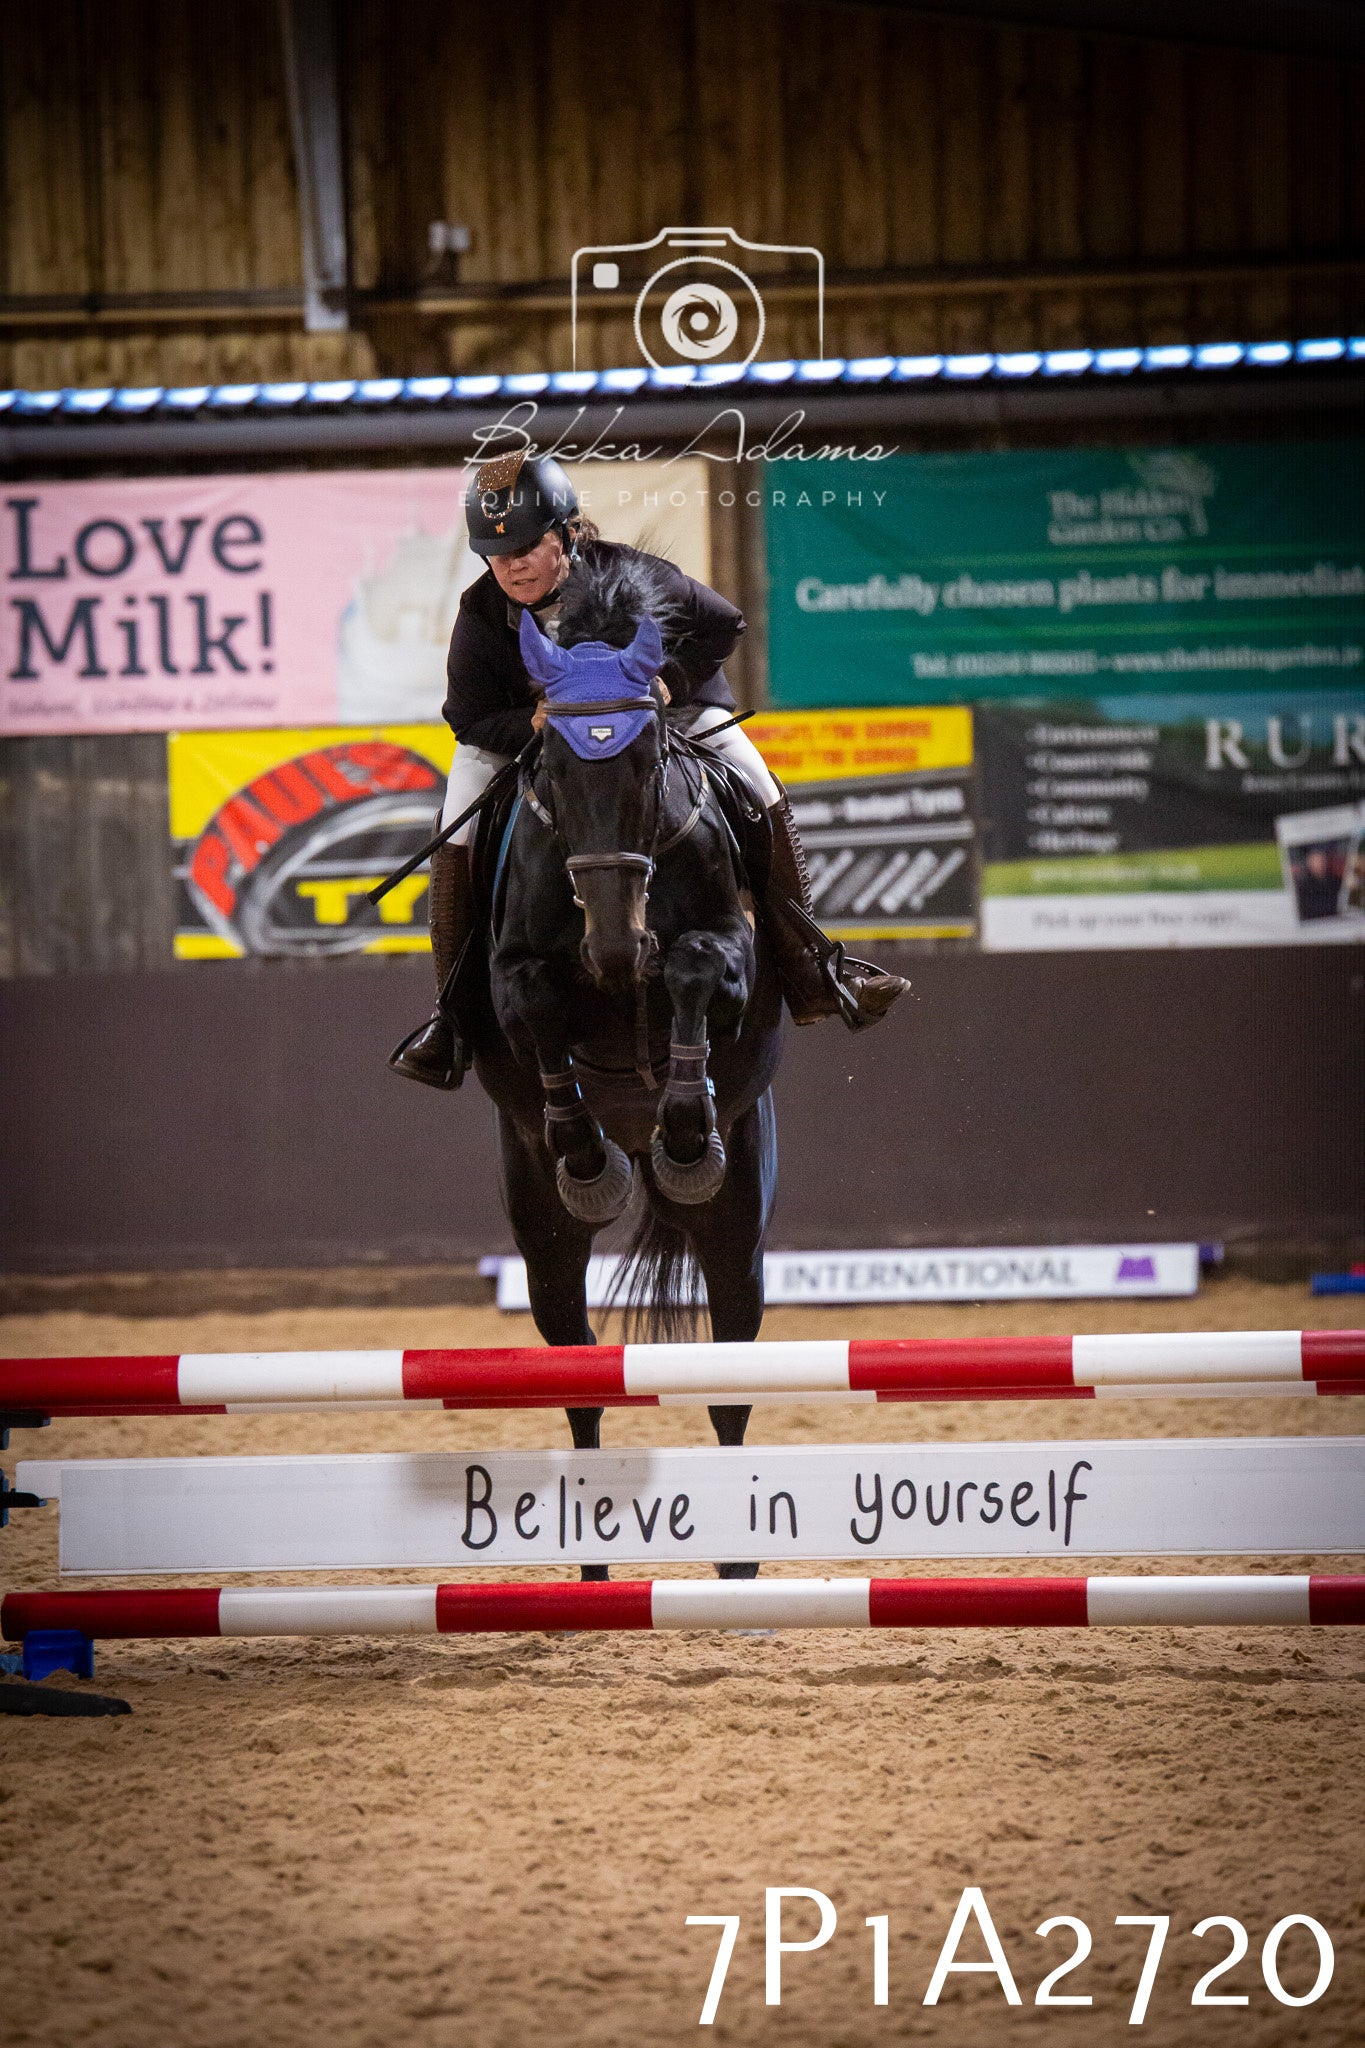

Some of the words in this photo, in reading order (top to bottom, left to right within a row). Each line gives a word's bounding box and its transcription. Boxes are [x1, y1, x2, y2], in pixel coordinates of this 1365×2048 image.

[8, 499, 265, 580] Love
[796, 574, 939, 615] Carefully
[942, 573, 1055, 609] chosen
[1058, 568, 1157, 613] plants
[1161, 564, 1210, 602] for
[9, 590, 276, 680] Milk!
[785, 1258, 1075, 1291] INTERNATIONAL
[462, 1464, 694, 1551] Believe
[749, 1475, 798, 1537] in
[850, 1460, 1094, 1546] yourself
